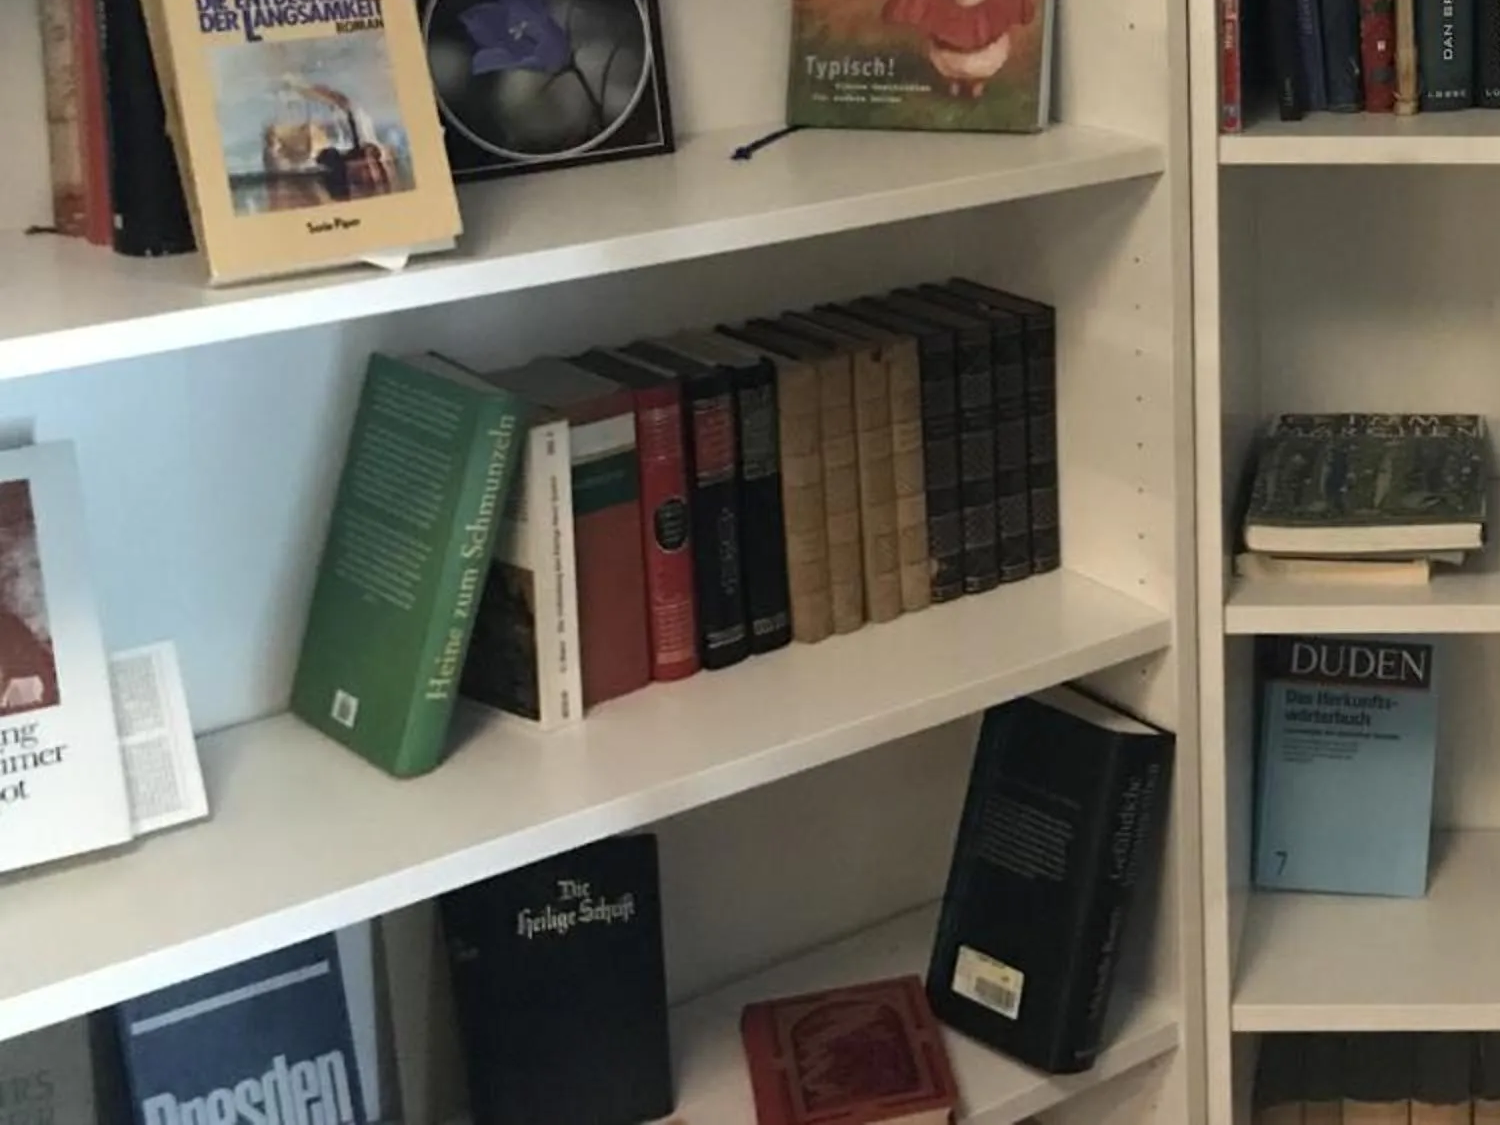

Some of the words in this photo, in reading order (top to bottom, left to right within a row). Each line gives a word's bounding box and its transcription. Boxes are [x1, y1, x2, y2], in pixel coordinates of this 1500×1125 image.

[198, 8, 239, 34] DER
[334, 17, 386, 35] ROMAN
[1443, 23, 1455, 61] DAN
[804, 54, 896, 81] Typisch!
[455, 410, 520, 563] Schmunzeln
[450, 565, 481, 619] zum
[422, 624, 466, 704] Heine
[1290, 641, 1427, 682] DUDEN
[1284, 688, 1313, 705] Das
[1284, 707, 1372, 727] wörterbuch
[556, 880, 591, 900] Die
